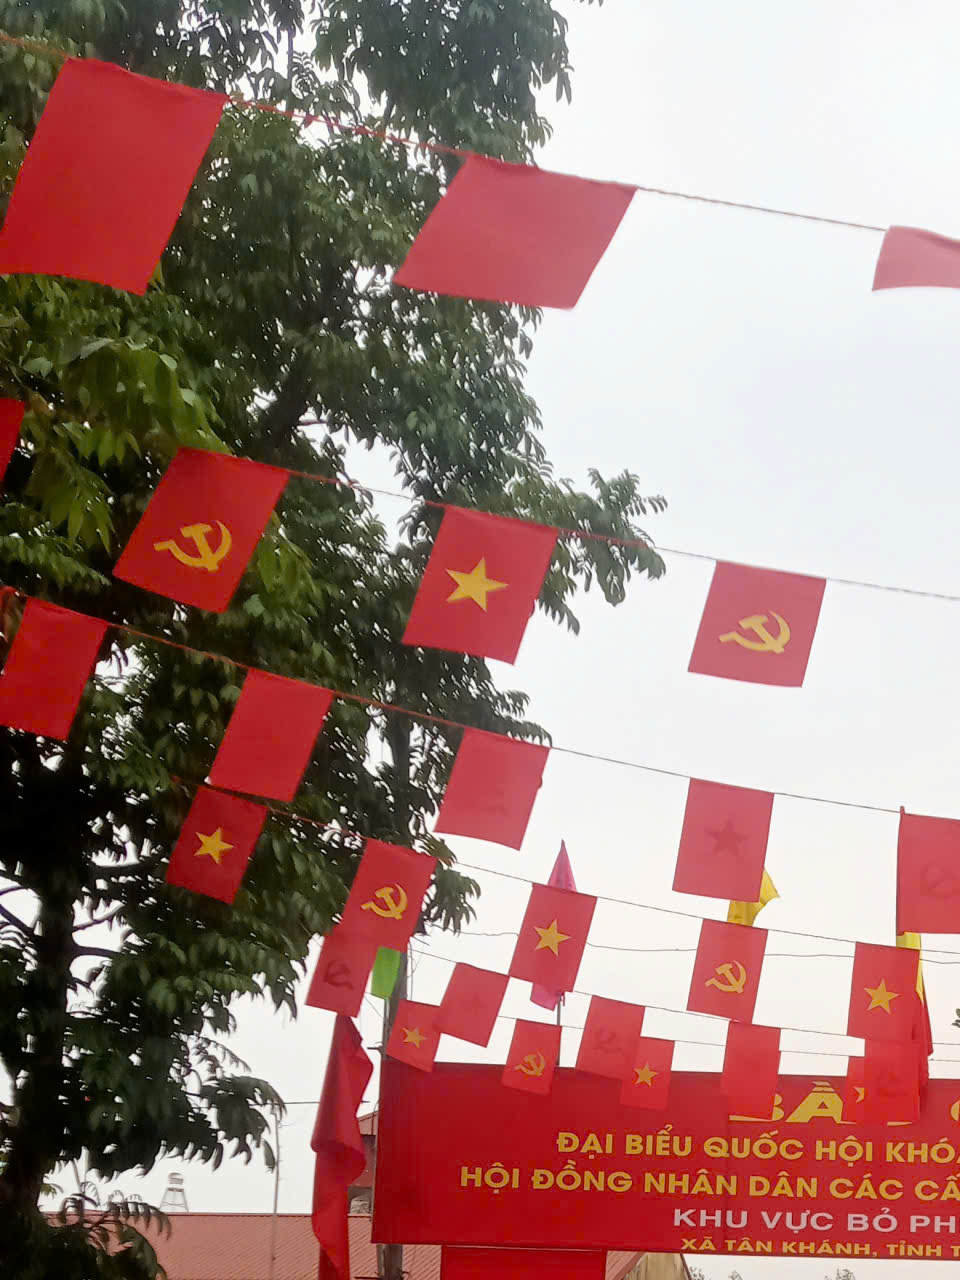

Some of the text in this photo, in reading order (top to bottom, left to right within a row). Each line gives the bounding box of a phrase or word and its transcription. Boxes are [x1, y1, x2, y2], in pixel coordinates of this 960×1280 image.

[556, 1132, 613, 1160] ĐẠI
[626, 1125, 691, 1156] BIỂU
[704, 1130, 803, 1160] QUỐC
[816, 1135, 872, 1167] HỘI
[461, 1162, 519, 1193] HỘI
[532, 1162, 632, 1192] ĐỒNG
[645, 1169, 736, 1195] NHÂN
[749, 1171, 817, 1197] DÂN
[829, 1173, 903, 1200] CÁC
[674, 1209, 747, 1228] KHU
[761, 1210, 833, 1233] VỰC
[848, 1207, 897, 1232] BỎ
[681, 1236, 717, 1253] XÃ
[724, 1237, 773, 1254] TÂN
[781, 1239, 879, 1257] KHÁNH,
[886, 1240, 942, 1258] TỈNH
